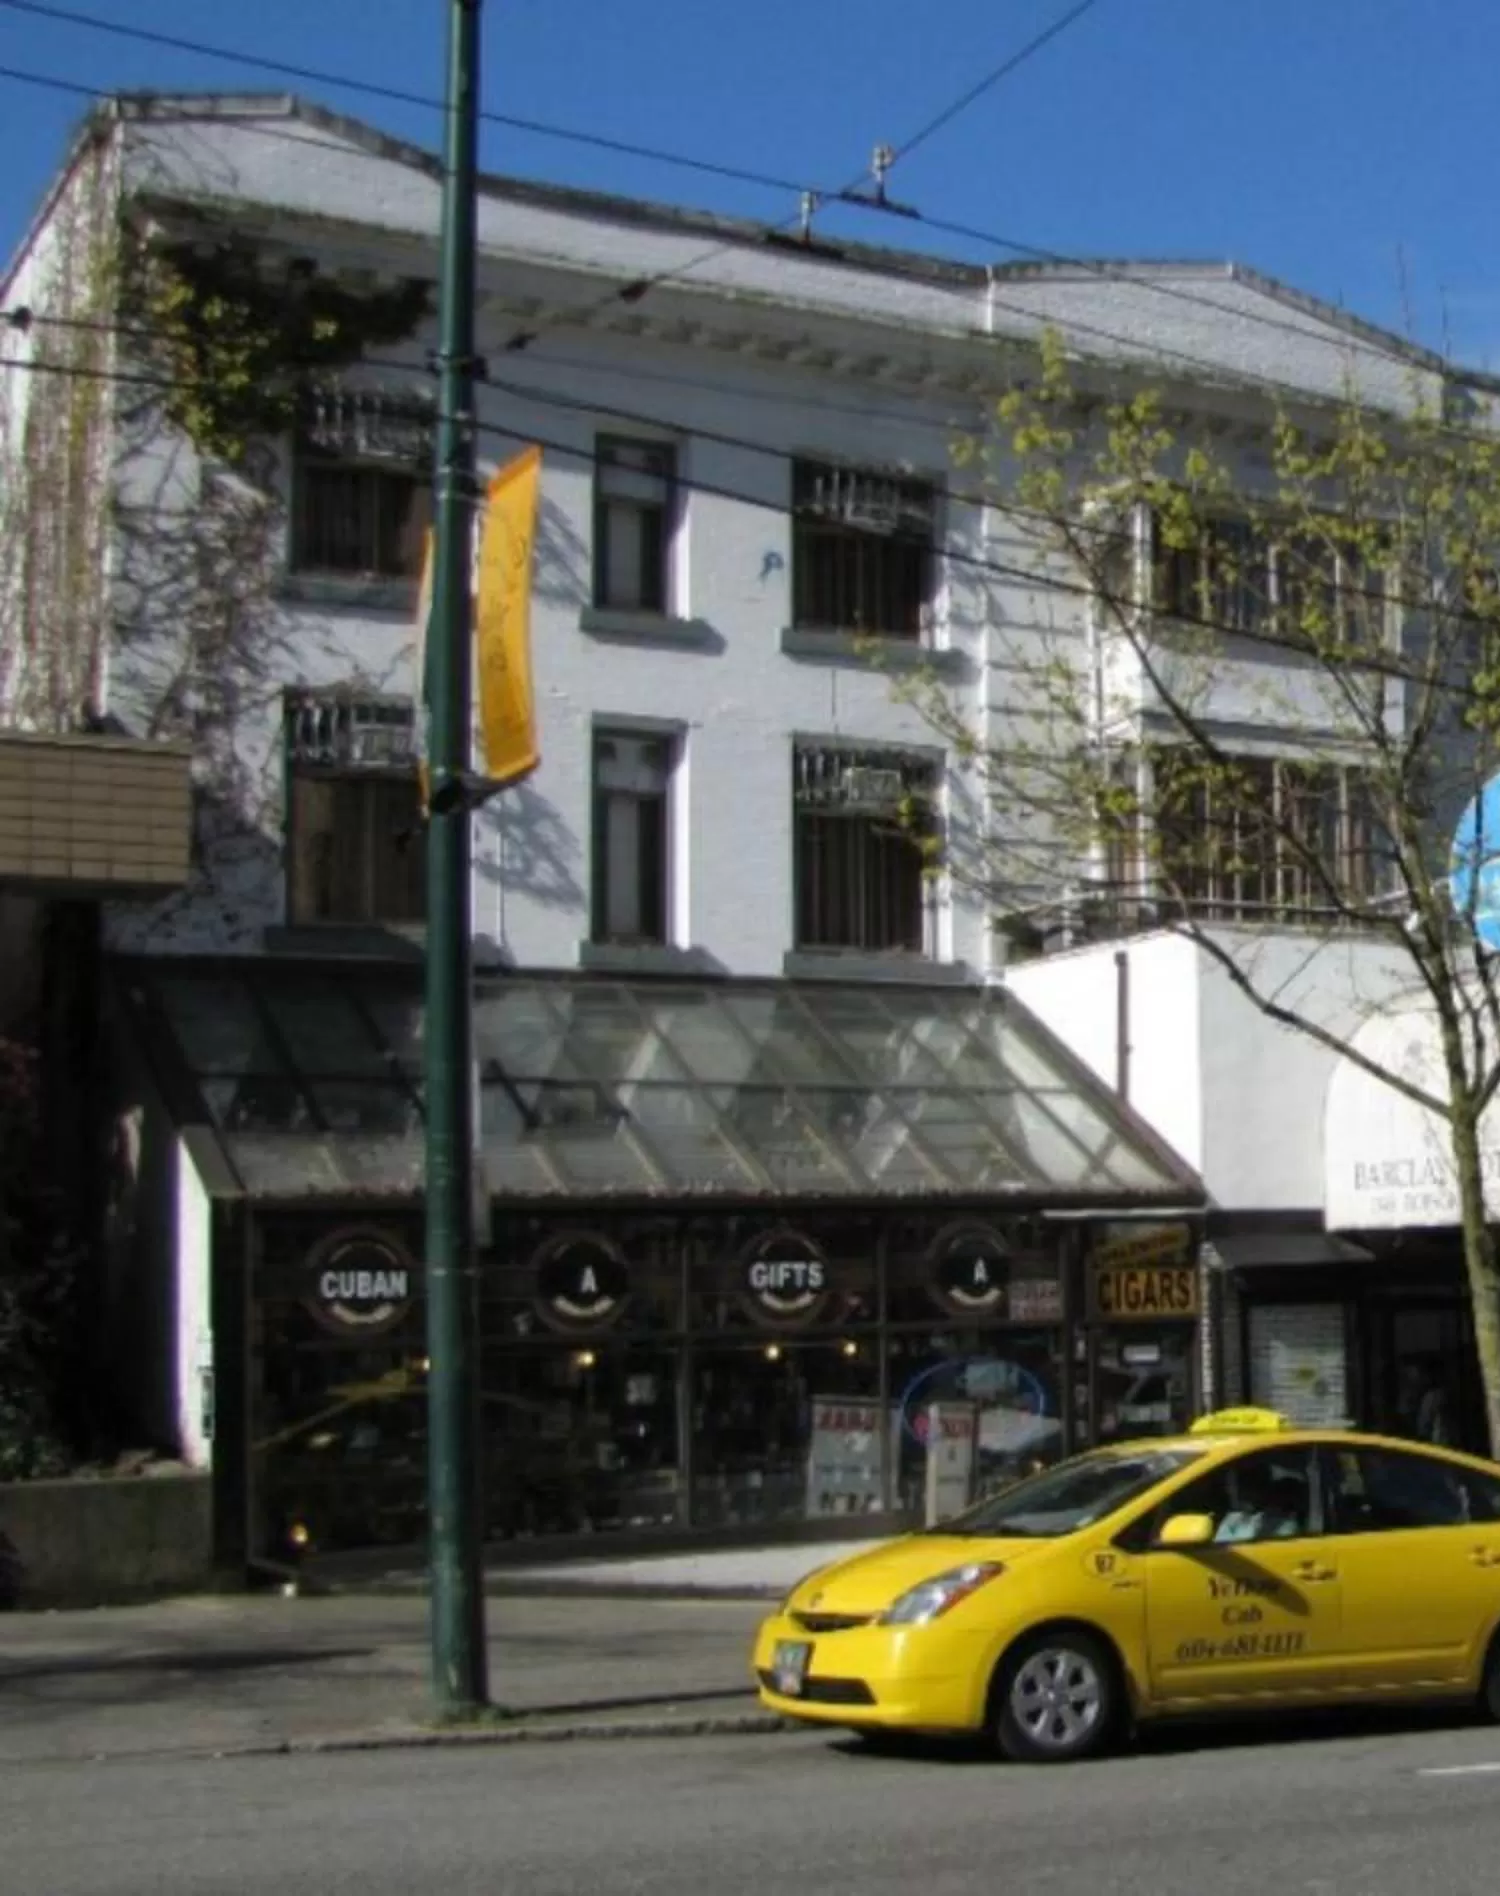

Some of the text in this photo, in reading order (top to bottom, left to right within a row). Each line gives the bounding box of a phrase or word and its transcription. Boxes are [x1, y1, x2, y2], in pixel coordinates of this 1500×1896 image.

[319, 1270, 408, 1299] CUBAN
[749, 1261, 824, 1289] GIFTS
[1098, 1270, 1191, 1312] CIGARS
[1221, 1602, 1264, 1627] Cab
